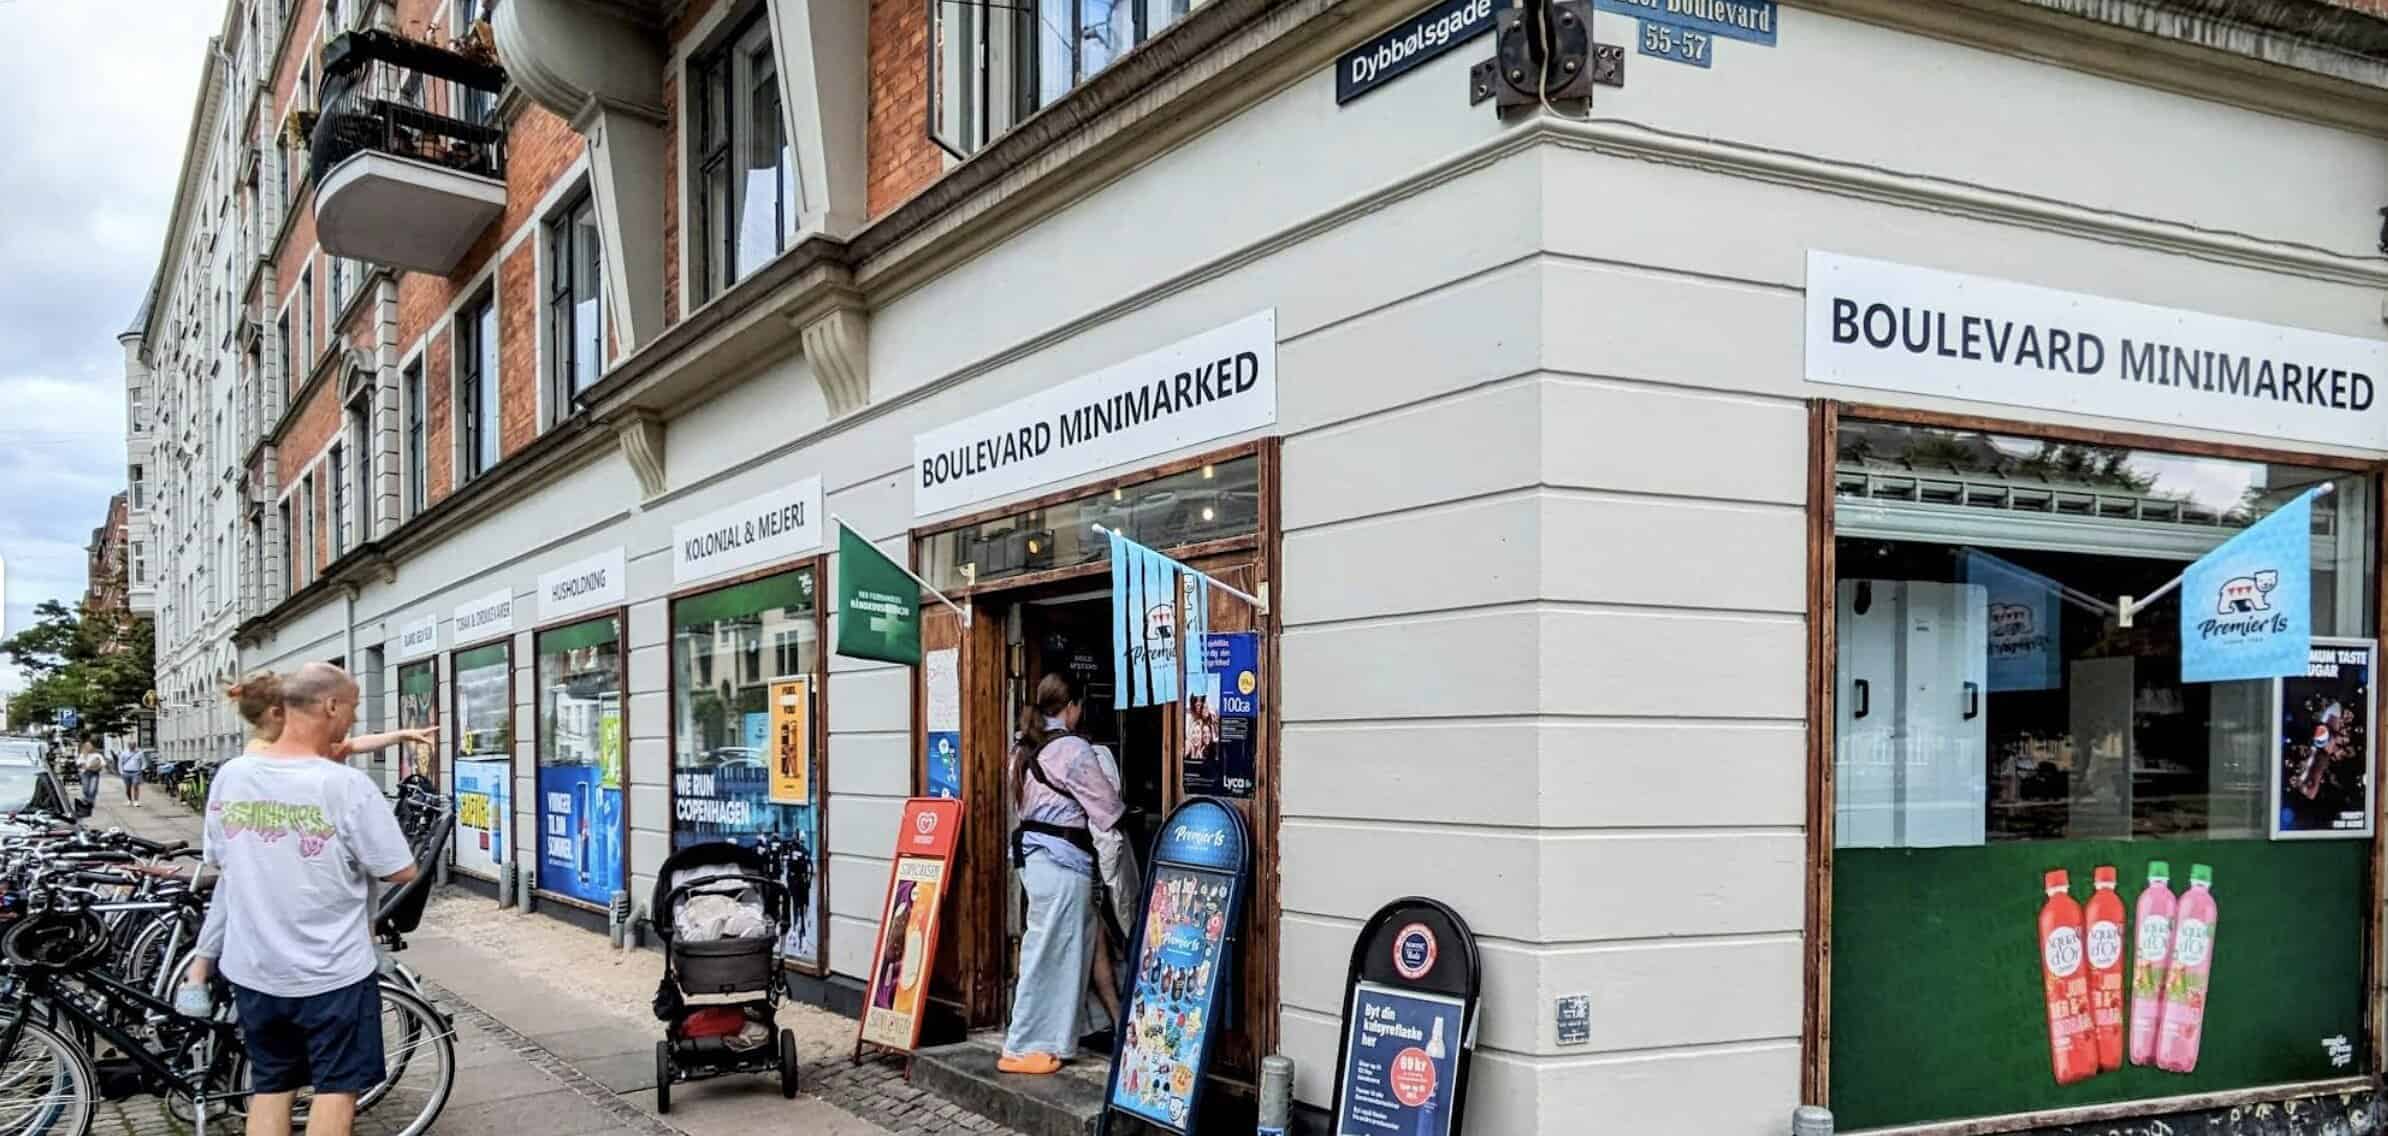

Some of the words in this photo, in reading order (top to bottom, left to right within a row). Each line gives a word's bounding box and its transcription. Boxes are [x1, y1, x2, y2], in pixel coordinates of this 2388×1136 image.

[1352, 0, 1491, 83] Dybbølsgade
[1646, 24, 1708, 60] 55-57
[1832, 296, 2106, 375] BOULEVARD
[2120, 338, 2375, 412] MINIMARKED
[922, 421, 1051, 488] BOULEVARD
[1059, 351, 1259, 449] MINIMARKED
[685, 524, 741, 563] KOLONIAL
[744, 520, 755, 544] &
[758, 501, 805, 541] MEJERI
[551, 568, 607, 602] HUSHOLDNING
[2197, 615, 2269, 640] Premier
[2337, 650, 2368, 665] TASTE
[2308, 663, 2338, 679] UGAR
[676, 773, 692, 796] WE
[693, 774, 715, 797] RUN
[1223, 775, 1244, 790] Lyca
[676, 799, 750, 825] COPENHAGEN
[1174, 825, 1214, 846] Premier
[1364, 1003, 1380, 1020] Byt
[1381, 1006, 1396, 1021] din
[1361, 1031, 1377, 1048] her
[1363, 1017, 1423, 1041] kulsyreflaske
